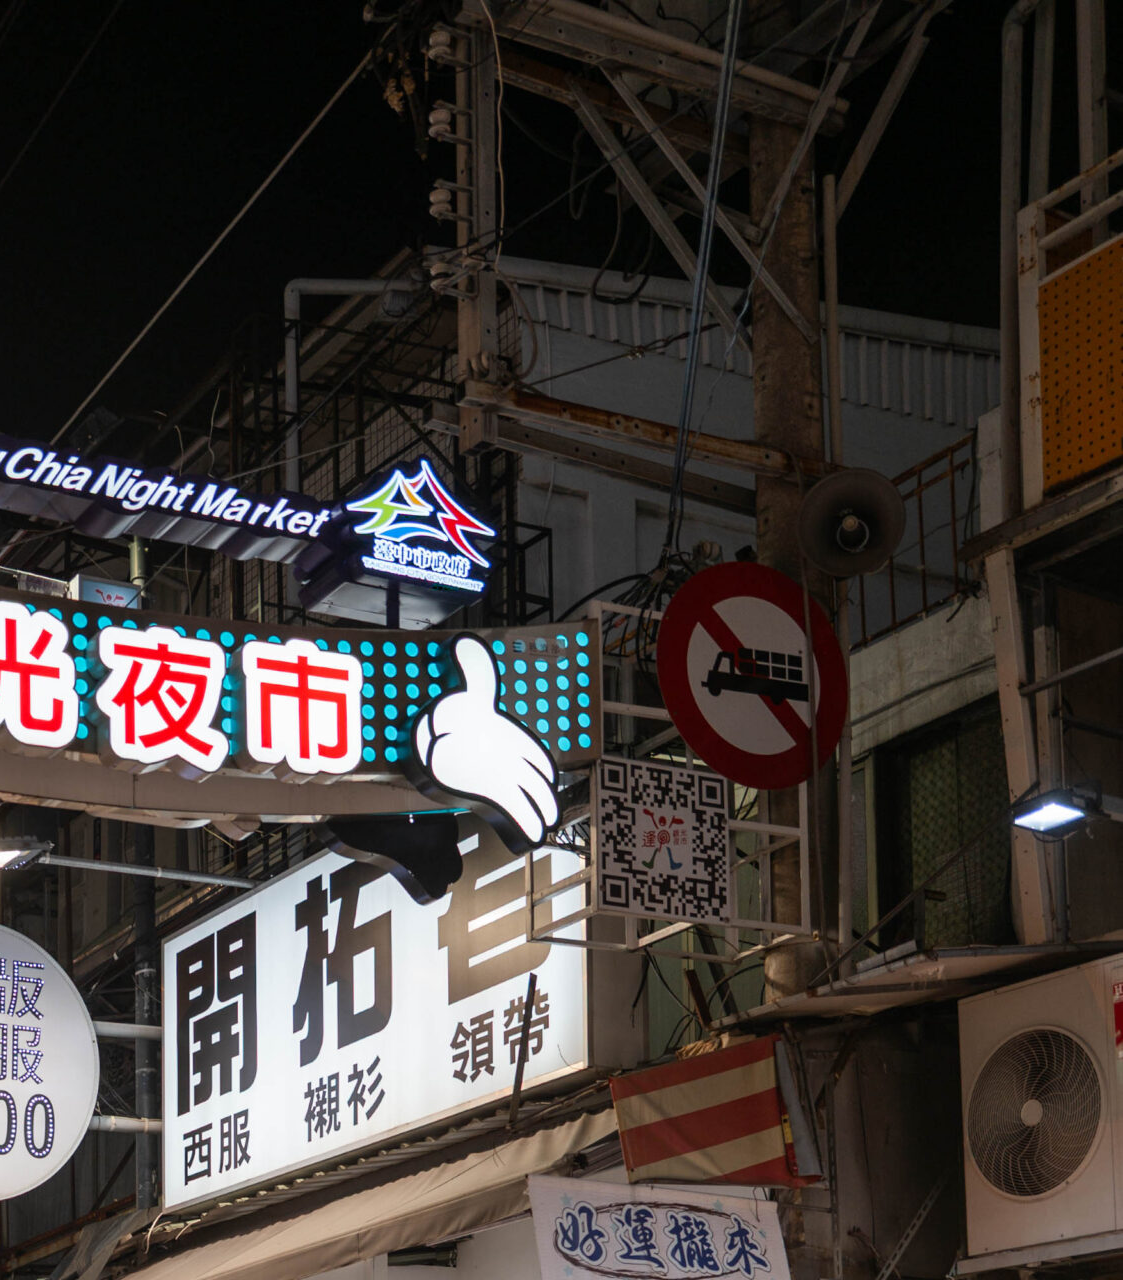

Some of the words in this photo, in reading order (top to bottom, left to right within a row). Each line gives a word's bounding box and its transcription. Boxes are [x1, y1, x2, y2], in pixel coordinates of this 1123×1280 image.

[5, 447, 93, 490] Chia
[91, 464, 195, 511] Night
[191, 485, 333, 538] Market
[363, 557, 405, 575] TAICHUNG
[406, 566, 426, 579] CITY
[426, 572, 483, 592] GOVERNMENT
[375, 539, 470, 577] 臺中市政府
[183, 1108, 252, 1186] 西服
[304, 1056, 387, 1143] 襯衫
[450, 997, 551, 1084] 領帶
